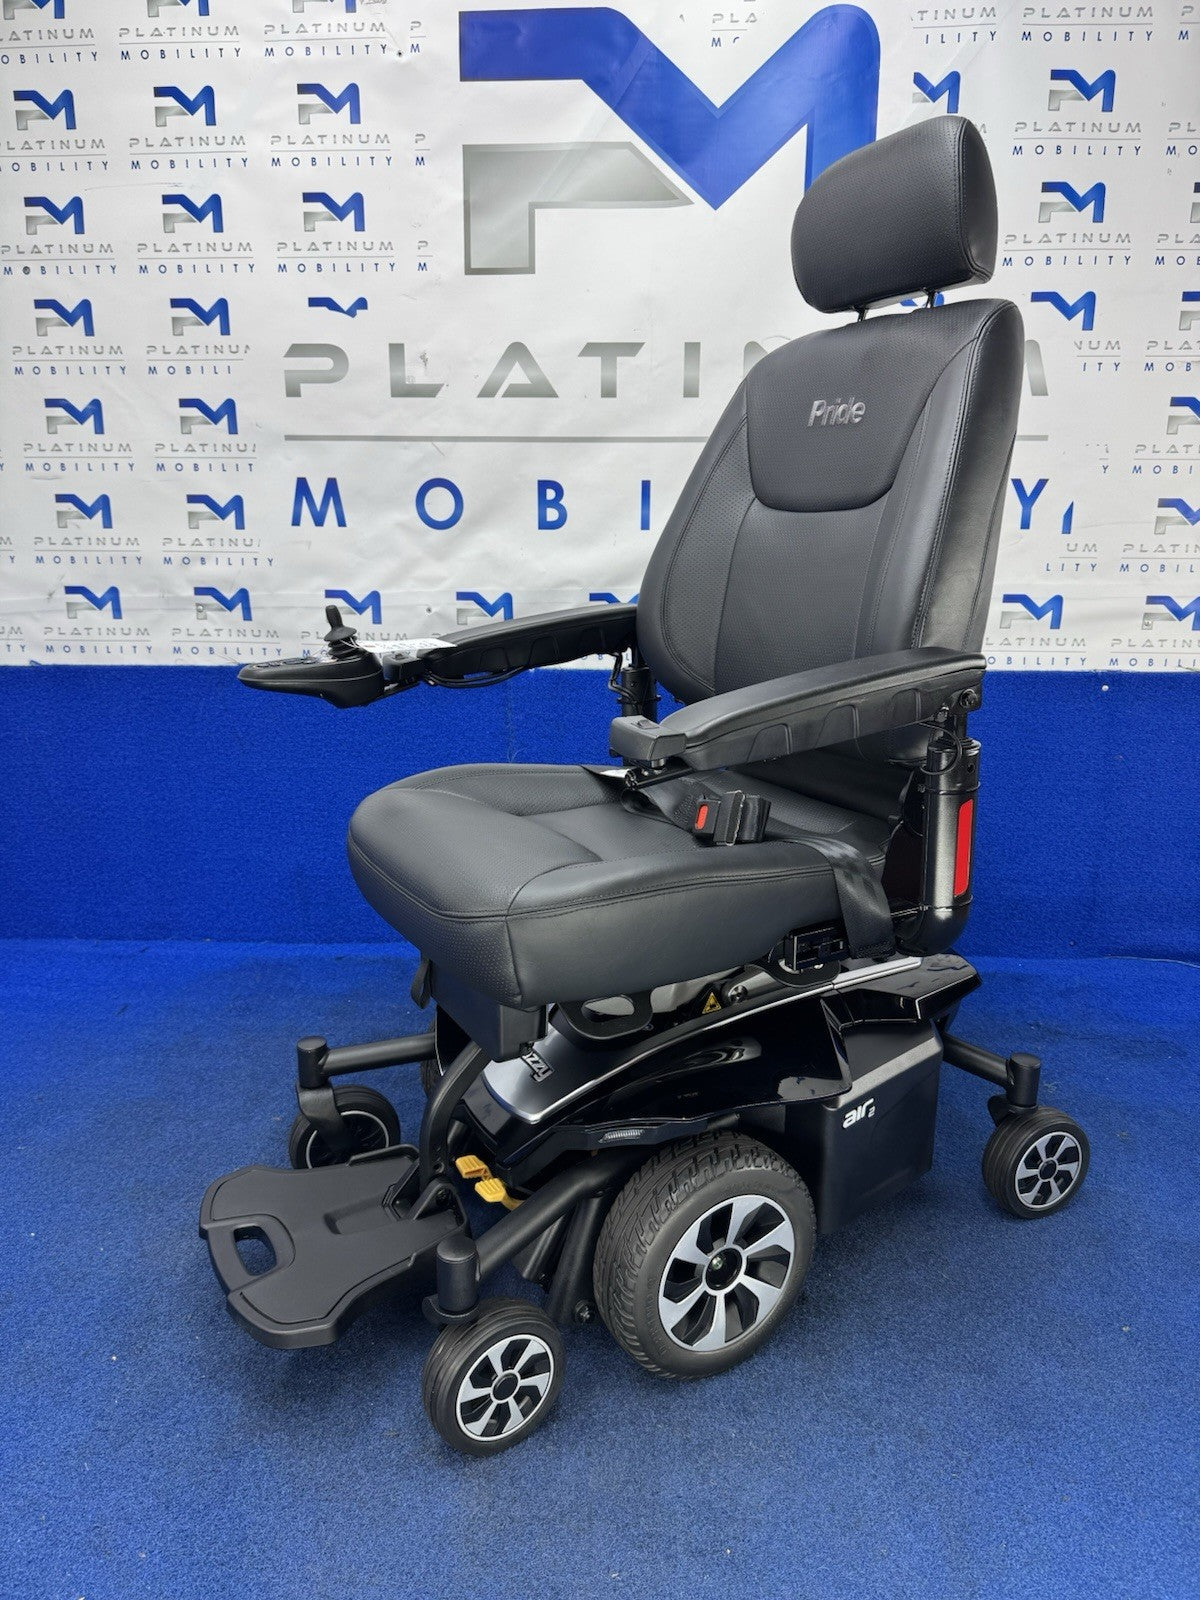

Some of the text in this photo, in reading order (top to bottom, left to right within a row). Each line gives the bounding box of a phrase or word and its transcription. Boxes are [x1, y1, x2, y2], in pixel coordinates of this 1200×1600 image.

[911, 7, 996, 21] TINUM
[1023, 6, 1153, 18] PLATINUM
[119, 26, 239, 37] PLATINUM
[264, 22, 385, 34] PLATINUM
[0, 26, 94, 42] ATINUM
[1021, 31, 1153, 42] MOBILITY
[121, 48, 241, 60] MOBILITY
[264, 44, 387, 57] MOBILITY
[1015, 122, 1141, 133] PLATINUM
[0, 139, 105, 150] LATINUM
[129, 136, 245, 147] PLATINUM
[271, 134, 390, 145] PLATINUM
[1013, 145, 1141, 156] MOBILITY
[131, 157, 248, 170] MOBILITY
[271, 156, 392, 166] MOBILITY
[0, 161, 108, 172] OBILITY
[1005, 233, 1131, 244] PLATINUM
[0, 244, 113, 254] PLATINUM
[137, 242, 252, 252] PLATINUM
[277, 242, 393, 251] PLATINUM
[1002, 256, 1131, 266] MOBILITY
[3, 264, 117, 275] MBILITY
[139, 264, 254, 274] MOBILITY
[278, 263, 395, 273] MOBILITY
[13, 346, 123, 355] PLATINUM
[15, 366, 126, 375] MOBILITY
[808, 397, 866, 427] Pride
[24, 443, 131, 452] PLATINUM
[25, 463, 134, 471] MOBILITY
[34, 537, 139, 545] PLATINUM
[162, 538, 262, 547] PLATINU
[36, 556, 141, 564] MOBILITY
[163, 556, 273, 566] MOBILITY
[44, 627, 149, 635] PLATINUM
[173, 628, 279, 638] PLATINUM
[986, 638, 1086, 646] LATINUM
[1111, 639, 1200, 647] PLATIN
[46, 645, 152, 653] MOBILITY
[174, 647, 281, 655] MOBILITY
[988, 656, 1087, 665] OBILITY
